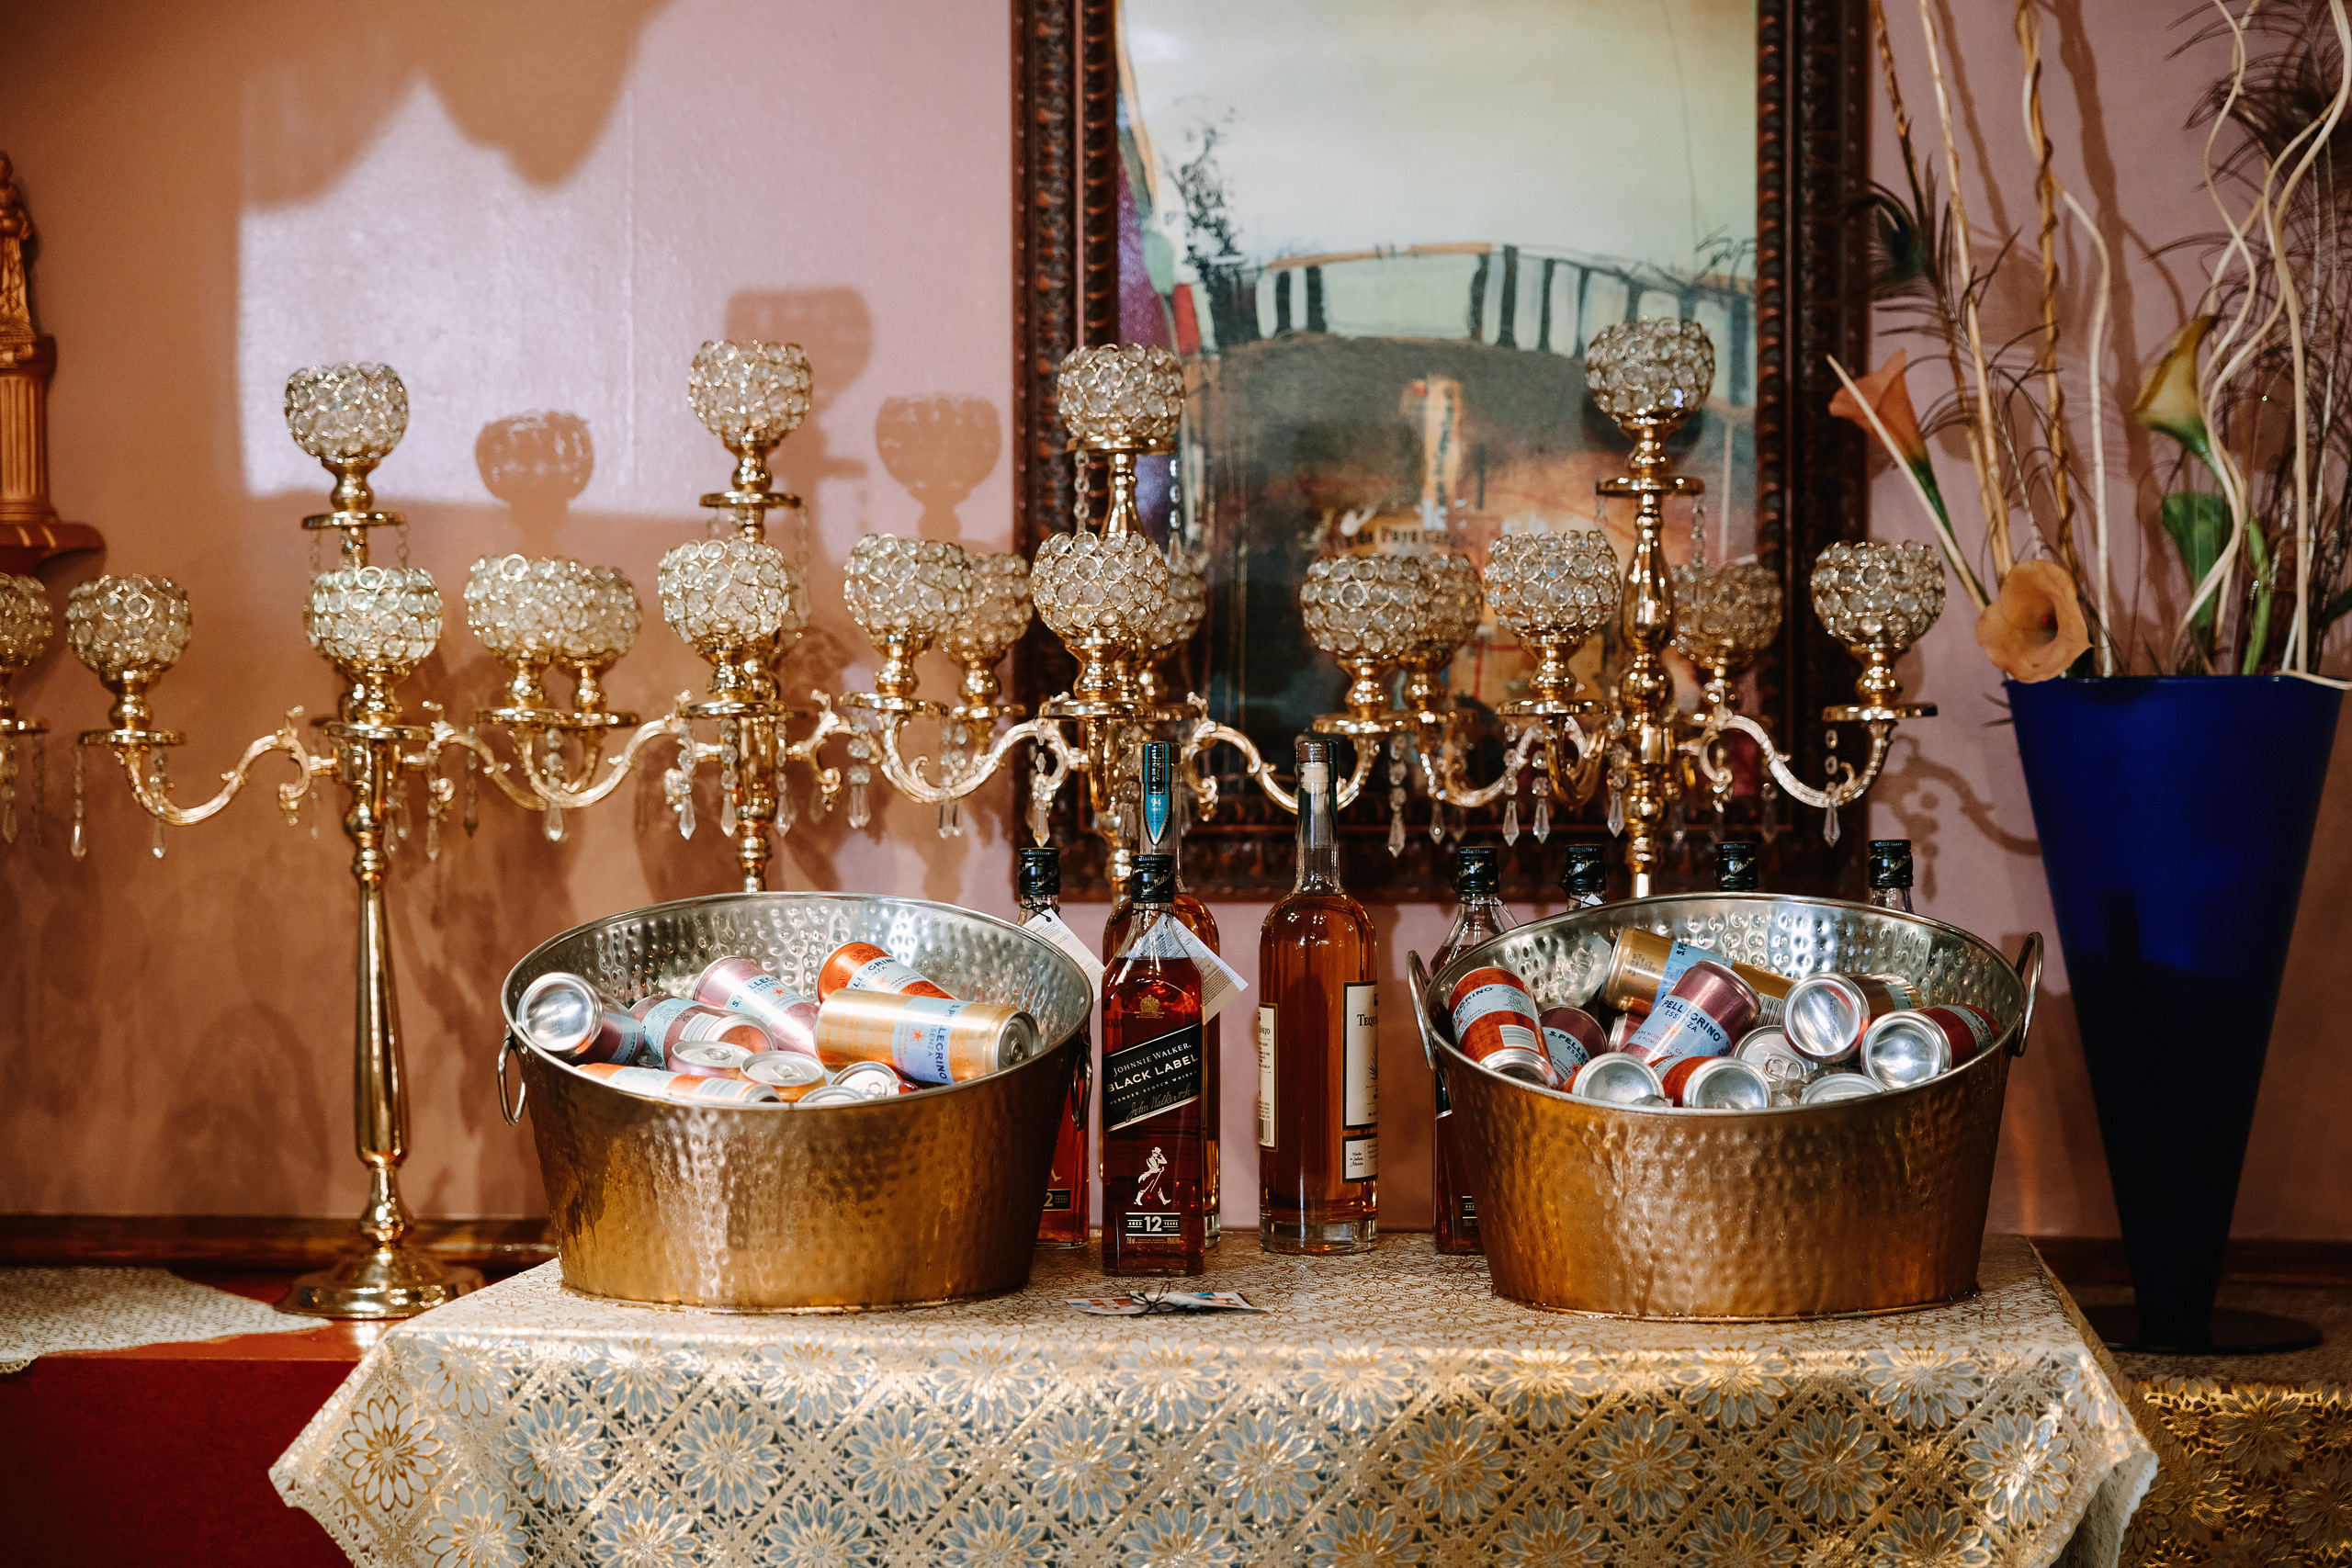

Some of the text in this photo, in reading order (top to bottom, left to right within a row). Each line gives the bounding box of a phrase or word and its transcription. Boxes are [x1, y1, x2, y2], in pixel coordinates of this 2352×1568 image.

[1113, 1043, 1189, 1077] JOHNNIE WALKER
[1106, 1054, 1199, 1093] BLACK LABEL
[1043, 1192, 1054, 1208] 2
[1143, 1215, 1162, 1233] 12
